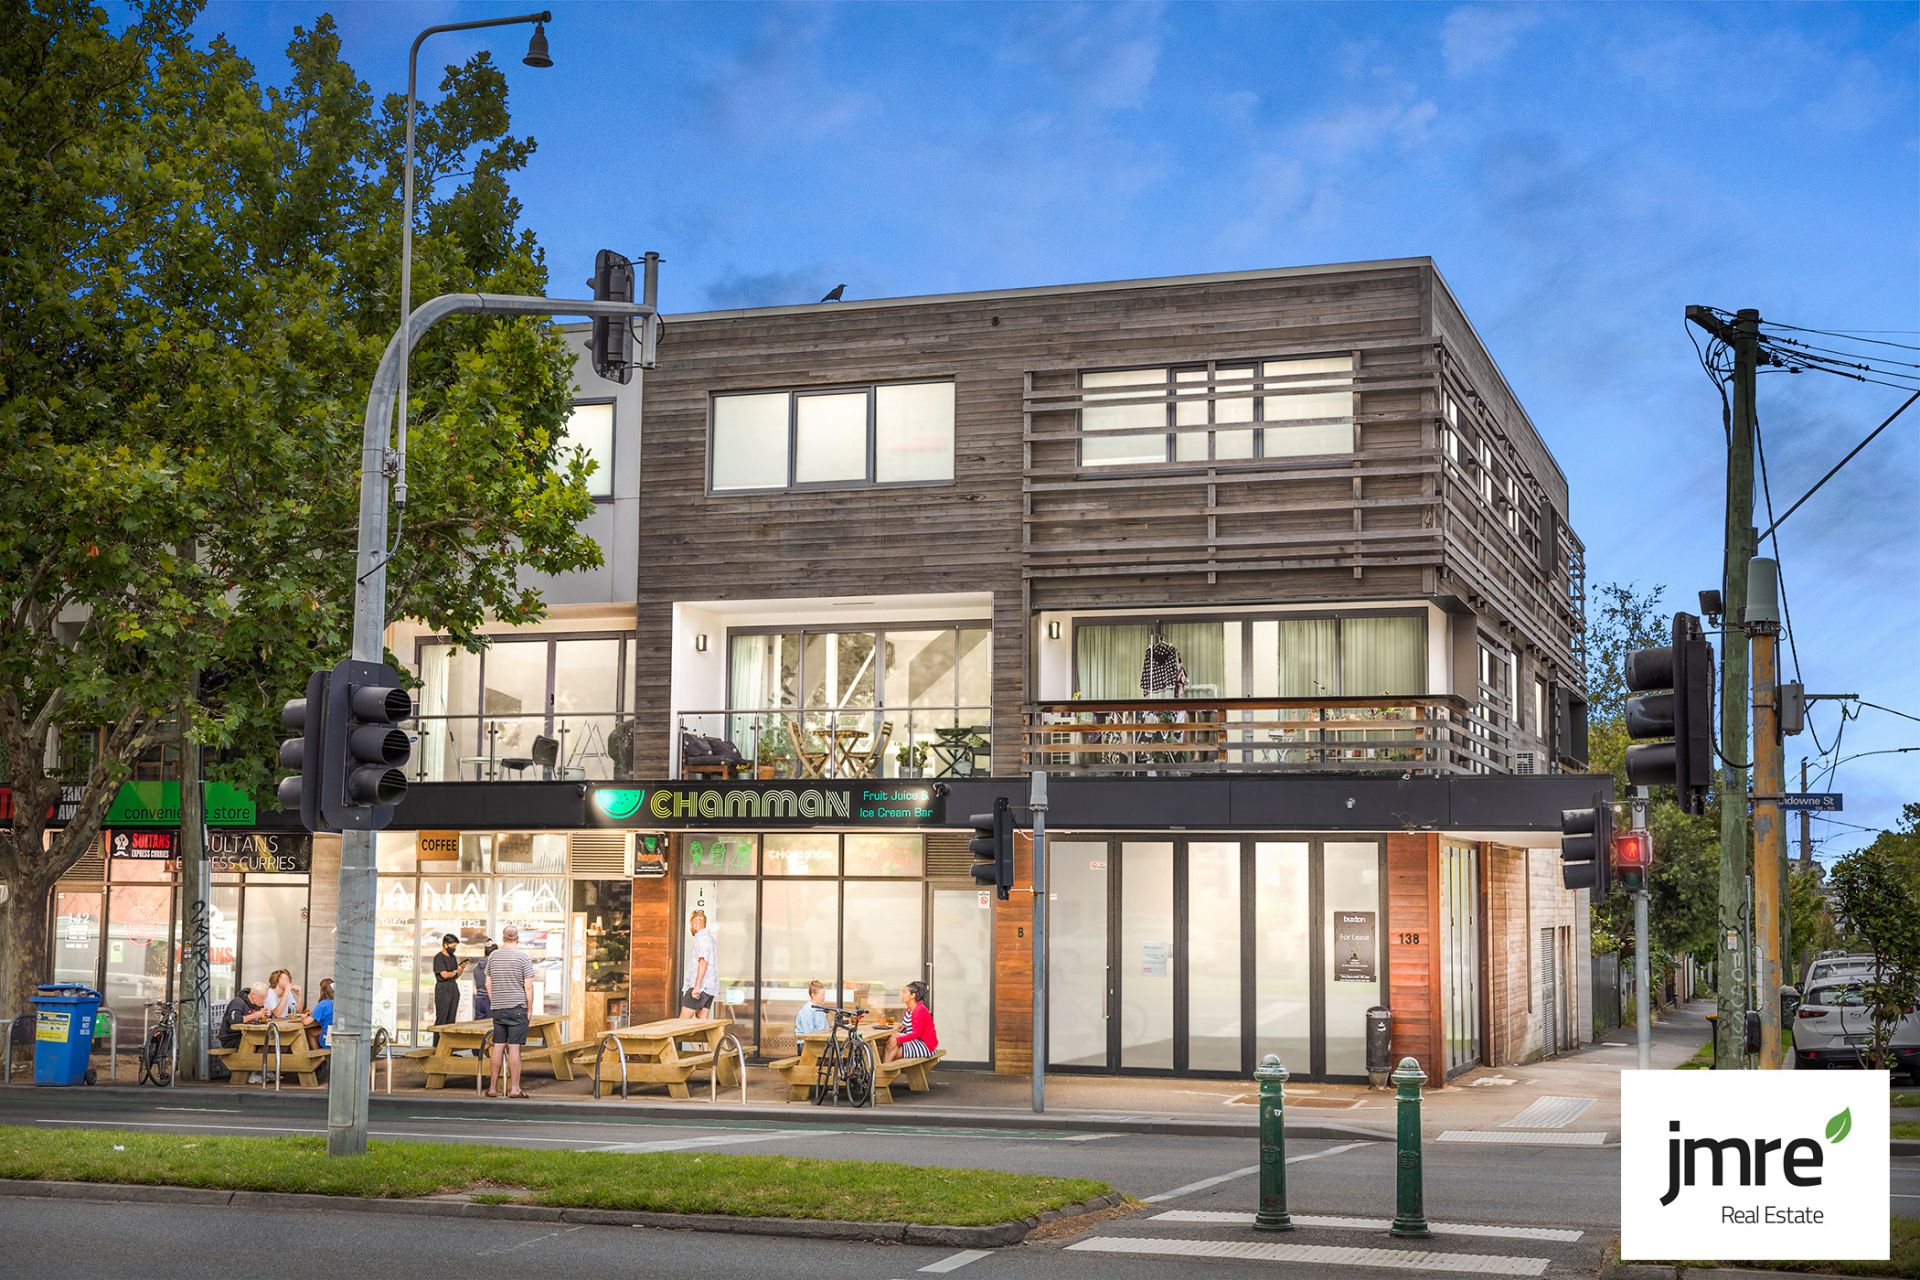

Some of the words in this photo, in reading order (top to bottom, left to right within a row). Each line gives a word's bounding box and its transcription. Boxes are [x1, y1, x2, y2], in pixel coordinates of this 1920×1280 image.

[863, 790, 888, 801] Fruit
[891, 790, 918, 801] Juice
[1823, 796, 1834, 806] St
[650, 789, 850, 818] CHAMMAN
[214, 806, 250, 819] store
[859, 807, 875, 818] Ice
[877, 807, 911, 818] Cream
[914, 807, 933, 818] Bar
[131, 833, 171, 849] SULTANS
[206, 835, 279, 854] ULTANS
[421, 839, 457, 852] COFFEE
[176, 855, 236, 870] EESS
[239, 855, 296, 871] CURRIES
[376, 881, 567, 914] ANAKA
[1351, 933, 1370, 941] Lease
[1398, 933, 1420, 945] 138
